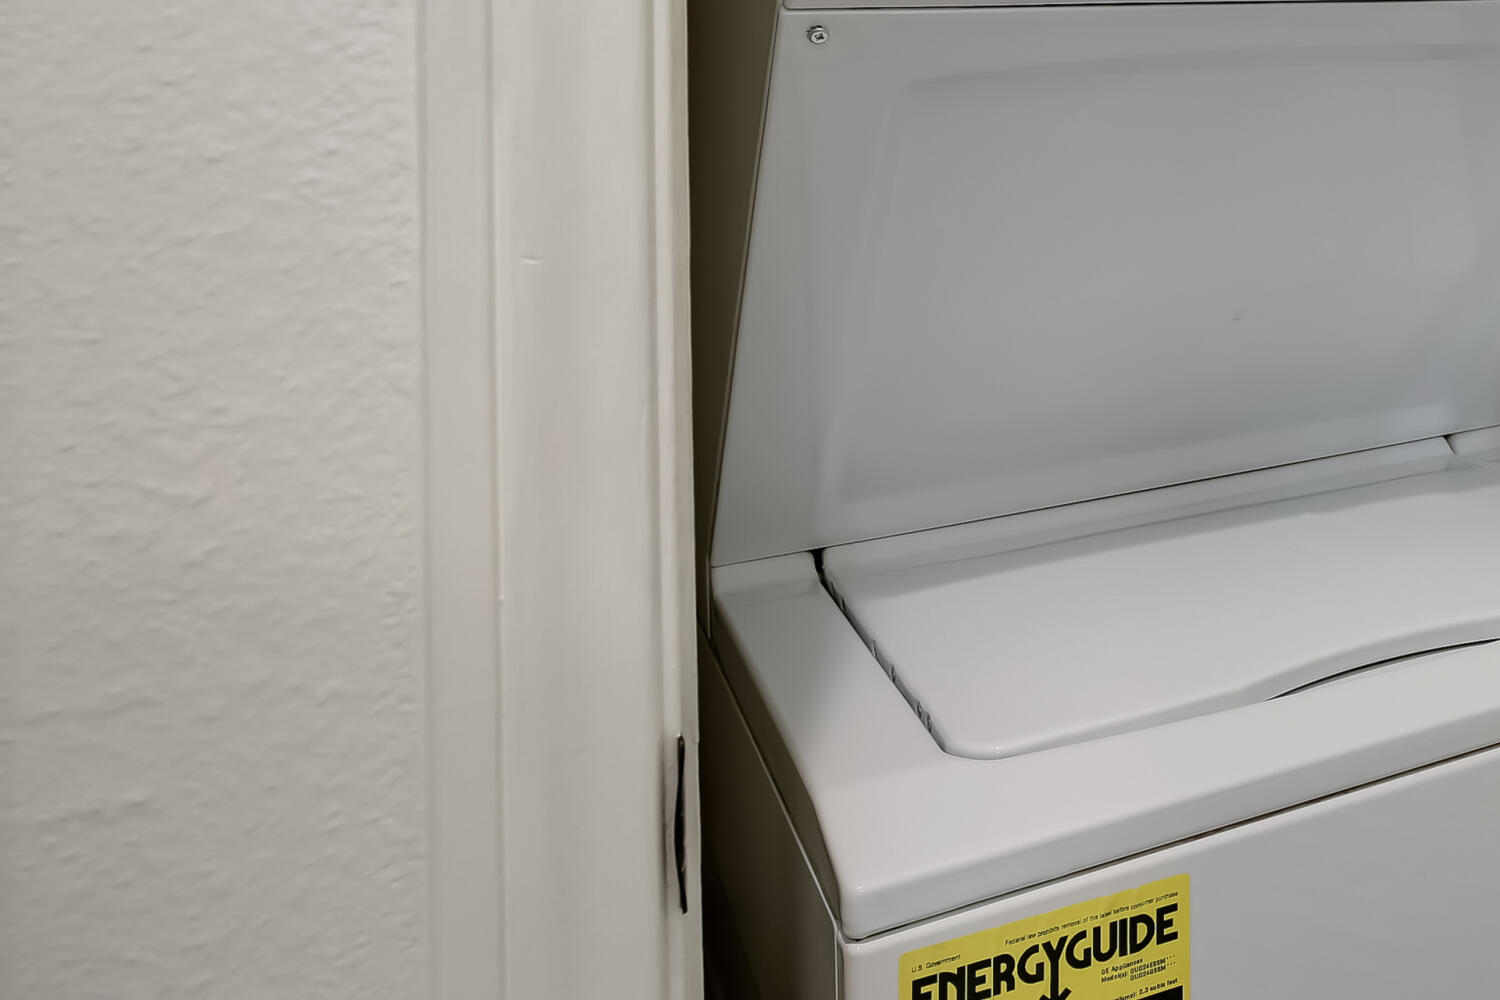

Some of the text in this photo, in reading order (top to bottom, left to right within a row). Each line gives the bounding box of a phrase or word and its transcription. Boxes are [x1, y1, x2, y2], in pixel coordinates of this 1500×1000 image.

[1005, 935, 1026, 946] Federal
[1037, 926, 1060, 938] prohibits
[1061, 920, 1081, 930] removal
[1090, 914, 1098, 922] this
[1100, 910, 1112, 918] label
[1113, 905, 1129, 915] before
[1130, 898, 1155, 910] consumer
[1155, 891, 1178, 904] purchase
[912, 903, 1179, 1000] ENERGYGUIDE
[926, 954, 961, 969] Government
[1111, 958, 1143, 971] Appliances
[1139, 978, 1178, 995] 2.3 cubic feet
